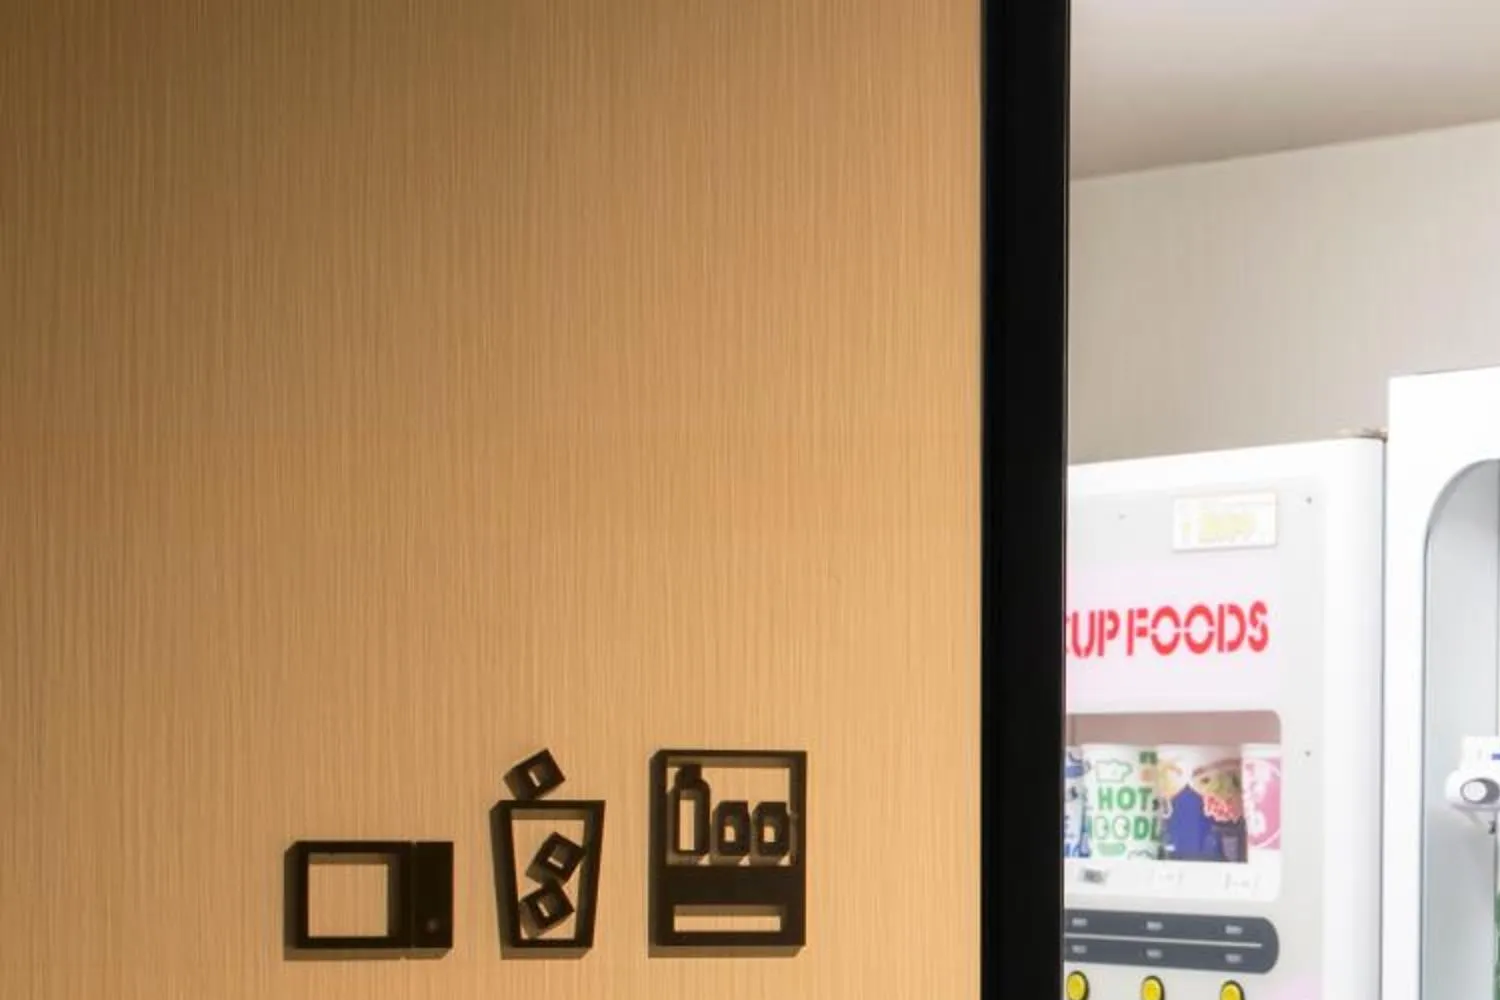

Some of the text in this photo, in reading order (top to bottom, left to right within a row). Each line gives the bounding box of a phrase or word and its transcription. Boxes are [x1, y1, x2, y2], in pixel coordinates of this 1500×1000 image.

[1065, 601, 1270, 658] UP FOODS
[1097, 787, 1153, 812] HOT
